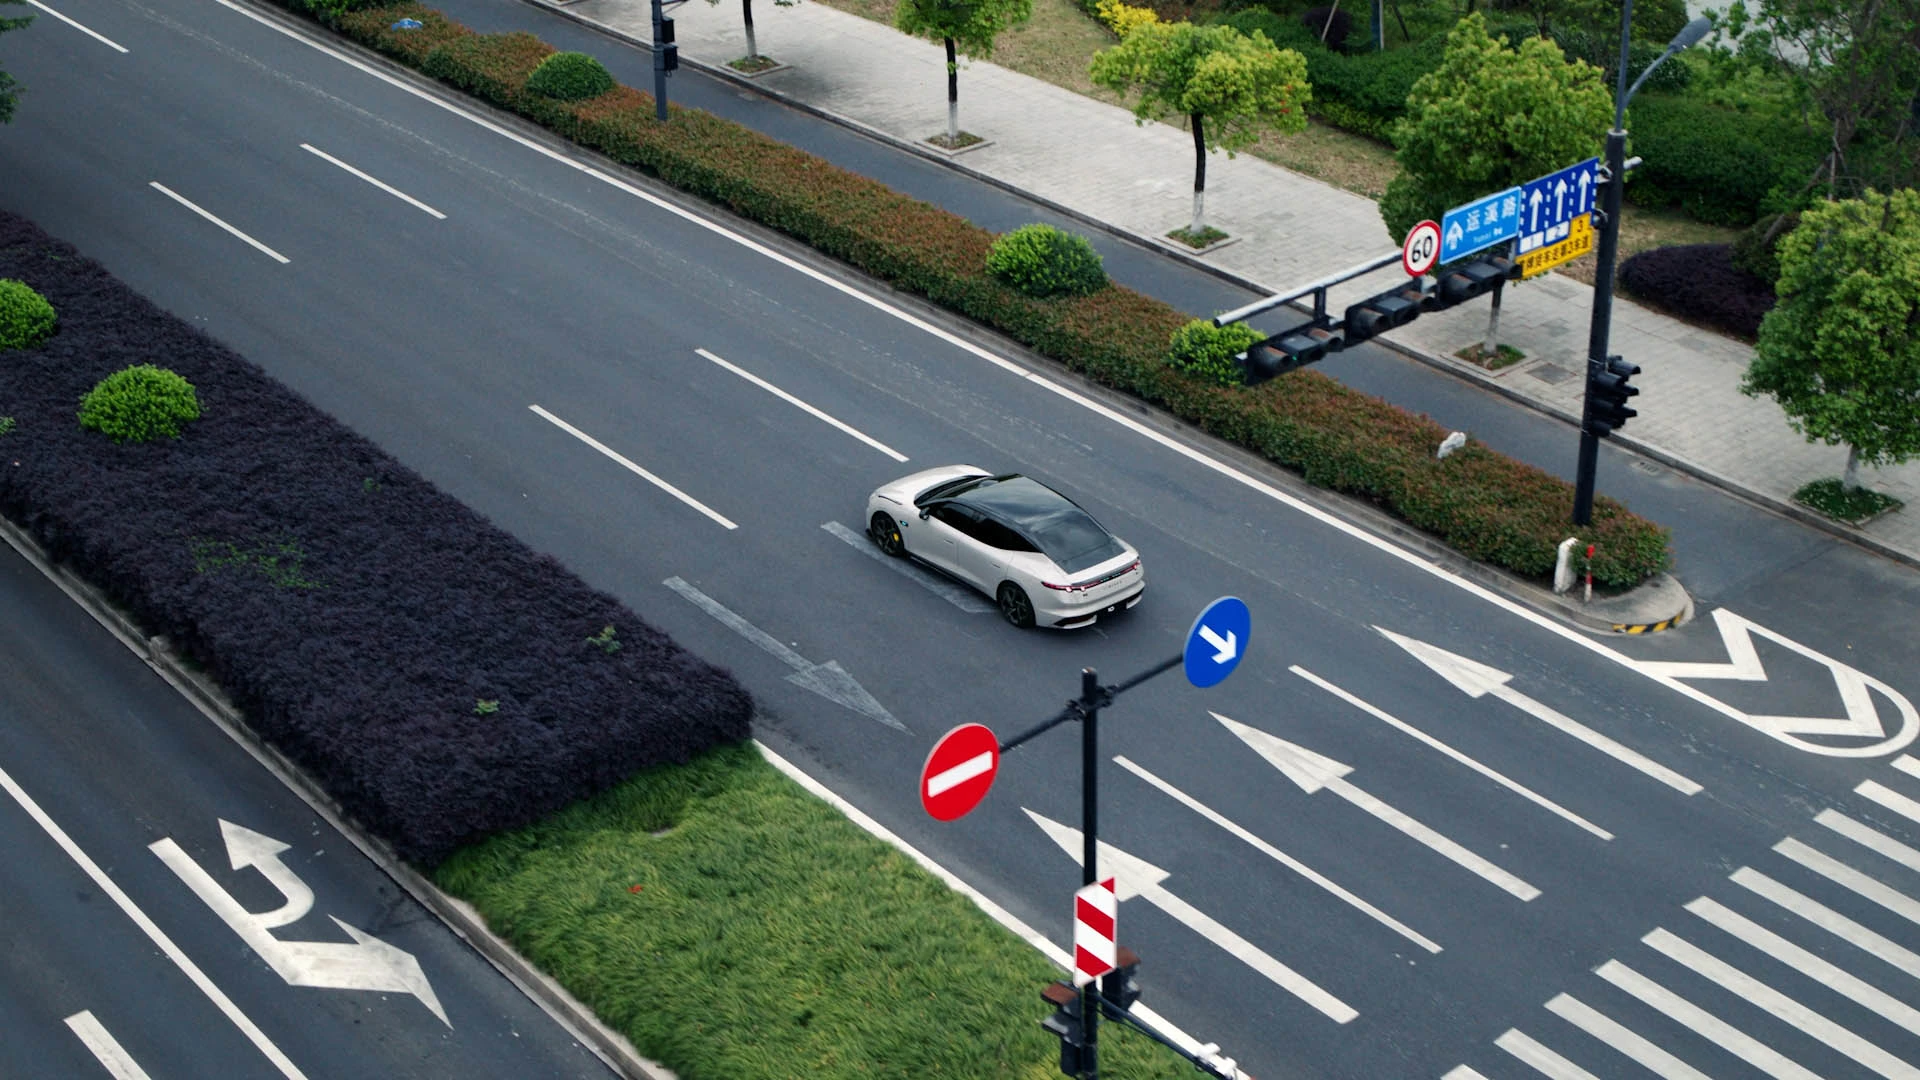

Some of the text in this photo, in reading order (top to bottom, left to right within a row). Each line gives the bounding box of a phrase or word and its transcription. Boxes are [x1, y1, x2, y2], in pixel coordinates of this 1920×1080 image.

[1465, 195, 1516, 232] 运溪路
[1577, 219, 1583, 232] 3
[1411, 235, 1433, 263] 60
